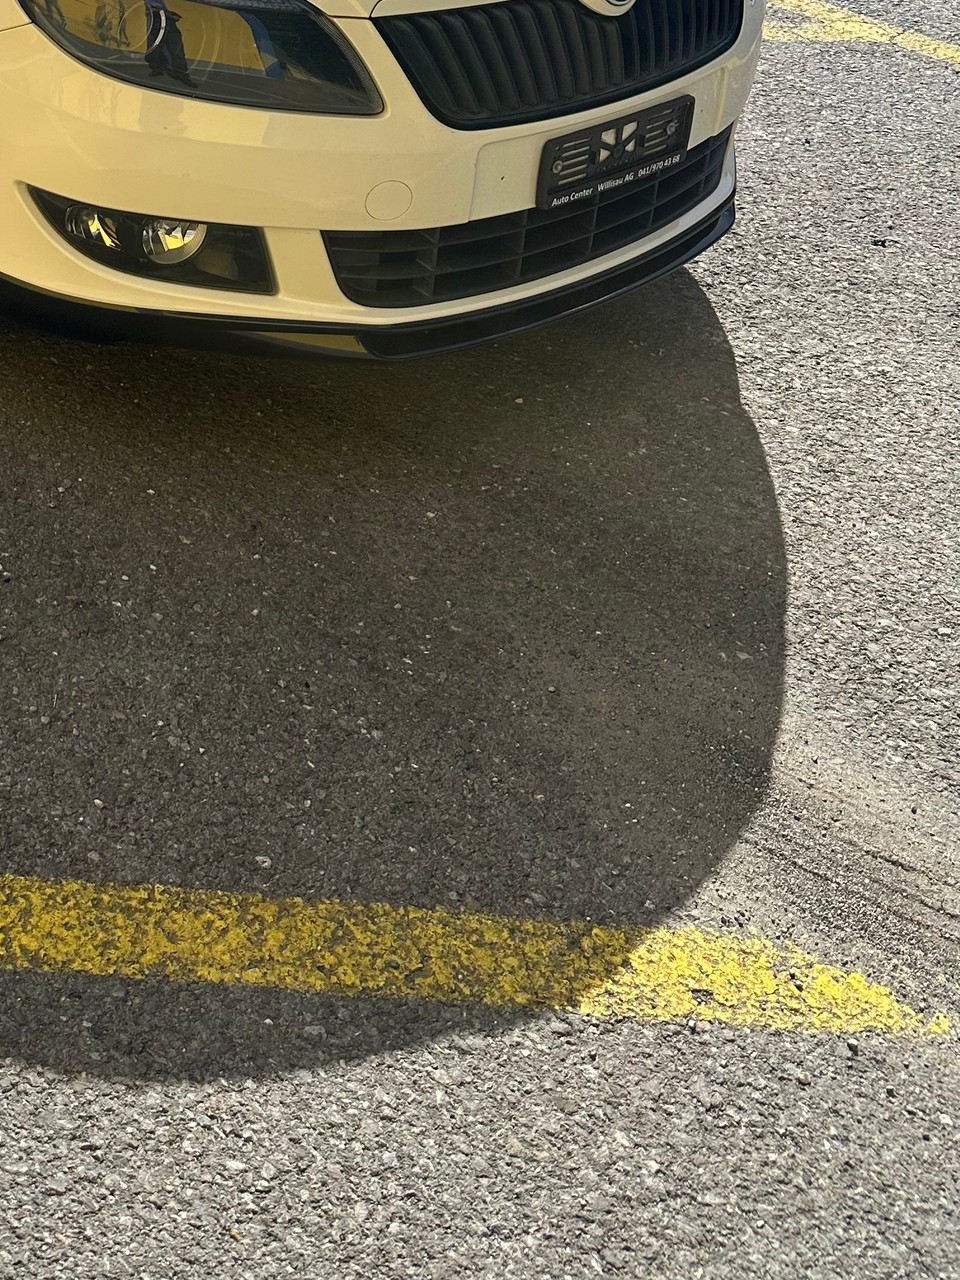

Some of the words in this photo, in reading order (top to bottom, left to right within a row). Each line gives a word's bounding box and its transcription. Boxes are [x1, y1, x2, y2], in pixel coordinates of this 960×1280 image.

[551, 194, 569, 207] Auto
[570, 187, 594, 201] Center
[597, 177, 624, 192] Willisau
[624, 172, 634, 183] AG
